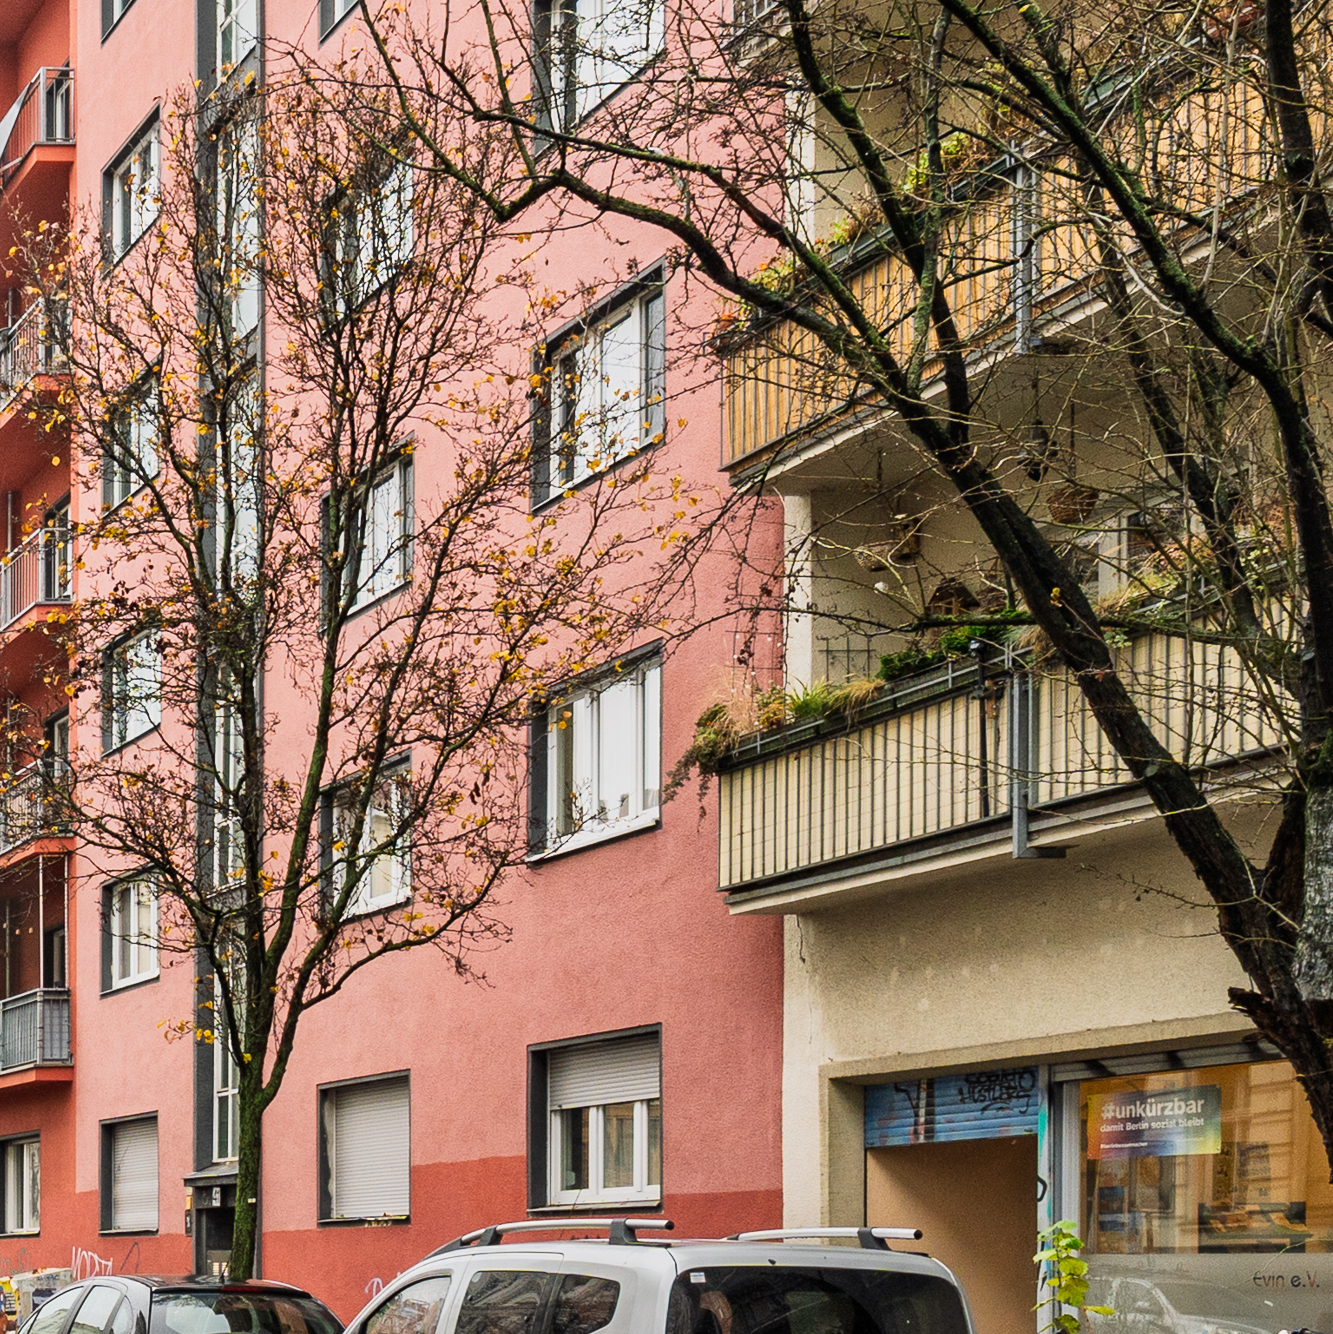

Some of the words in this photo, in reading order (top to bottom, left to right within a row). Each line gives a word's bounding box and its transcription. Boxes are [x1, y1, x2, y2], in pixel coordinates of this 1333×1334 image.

[1101, 1098, 1205, 1119] #unkürzbar
[1100, 1122, 1124, 1132] damit
[1125, 1120, 1149, 1131] Berlin
[1151, 1118, 1176, 1129] sozial
[1179, 1117, 1204, 1127] bleibt
[1253, 1271, 1285, 1288] Evin
[1290, 1270, 1320, 1288] e.V.
